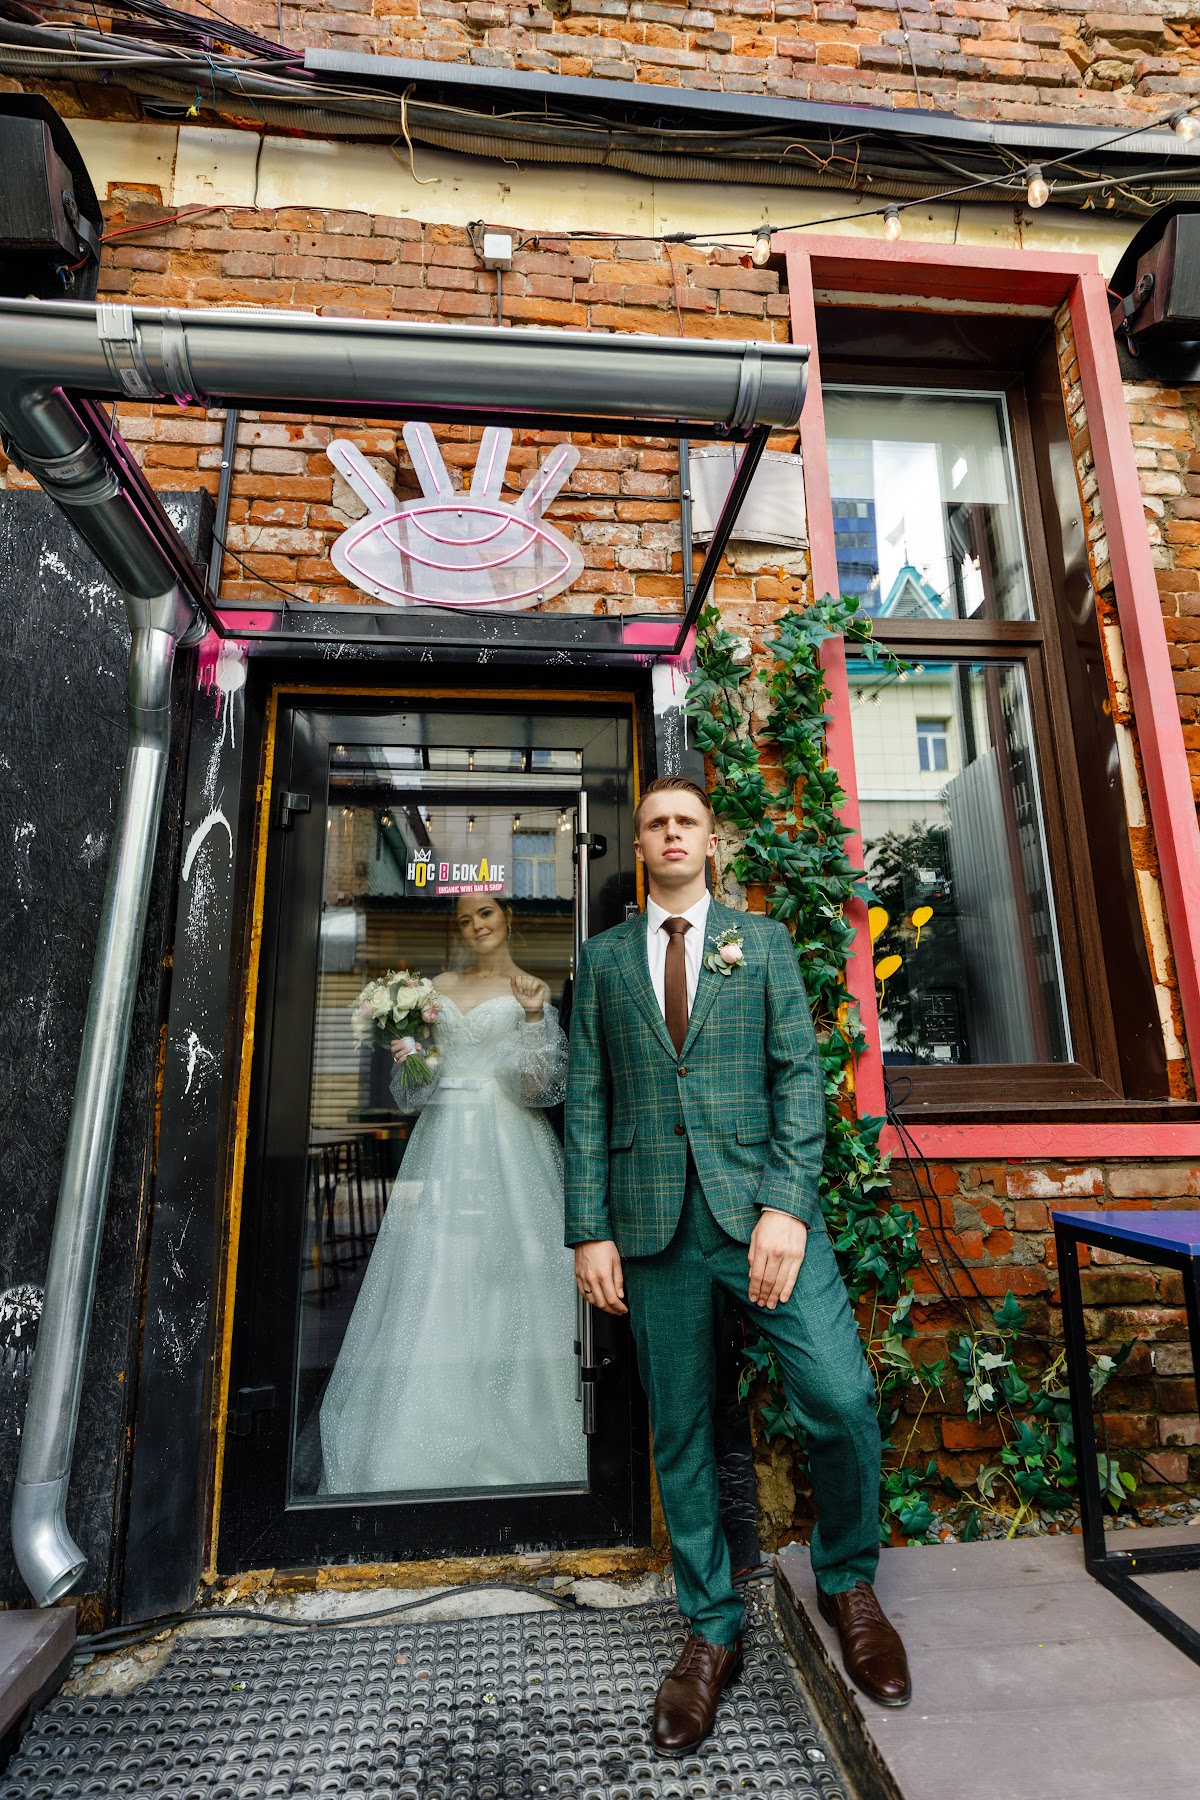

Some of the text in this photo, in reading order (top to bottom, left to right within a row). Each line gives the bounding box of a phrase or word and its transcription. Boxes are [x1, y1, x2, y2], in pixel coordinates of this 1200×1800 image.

[407, 858, 505, 887] НОС В БОКАЛЕ
[438, 883, 503, 894] ORGANIC WINE BAR & SHOP
